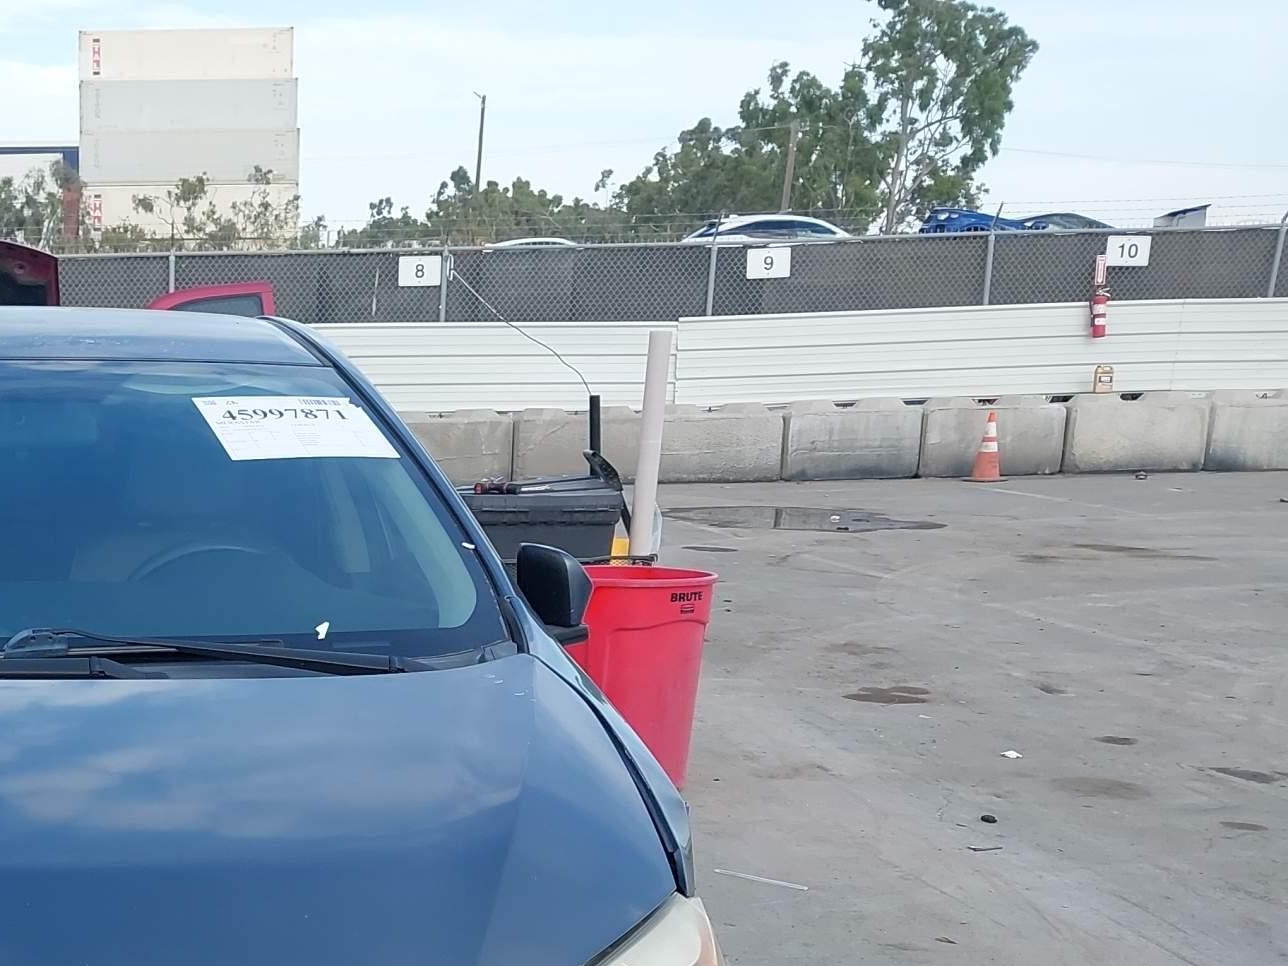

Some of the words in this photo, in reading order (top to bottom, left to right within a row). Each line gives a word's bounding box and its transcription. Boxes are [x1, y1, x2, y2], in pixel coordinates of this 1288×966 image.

[1118, 243, 1139, 259] 10
[415, 263, 425, 279] 8
[763, 255, 774, 271] 9
[222, 408, 350, 421] 45997871
[670, 591, 704, 603] BRUTE
